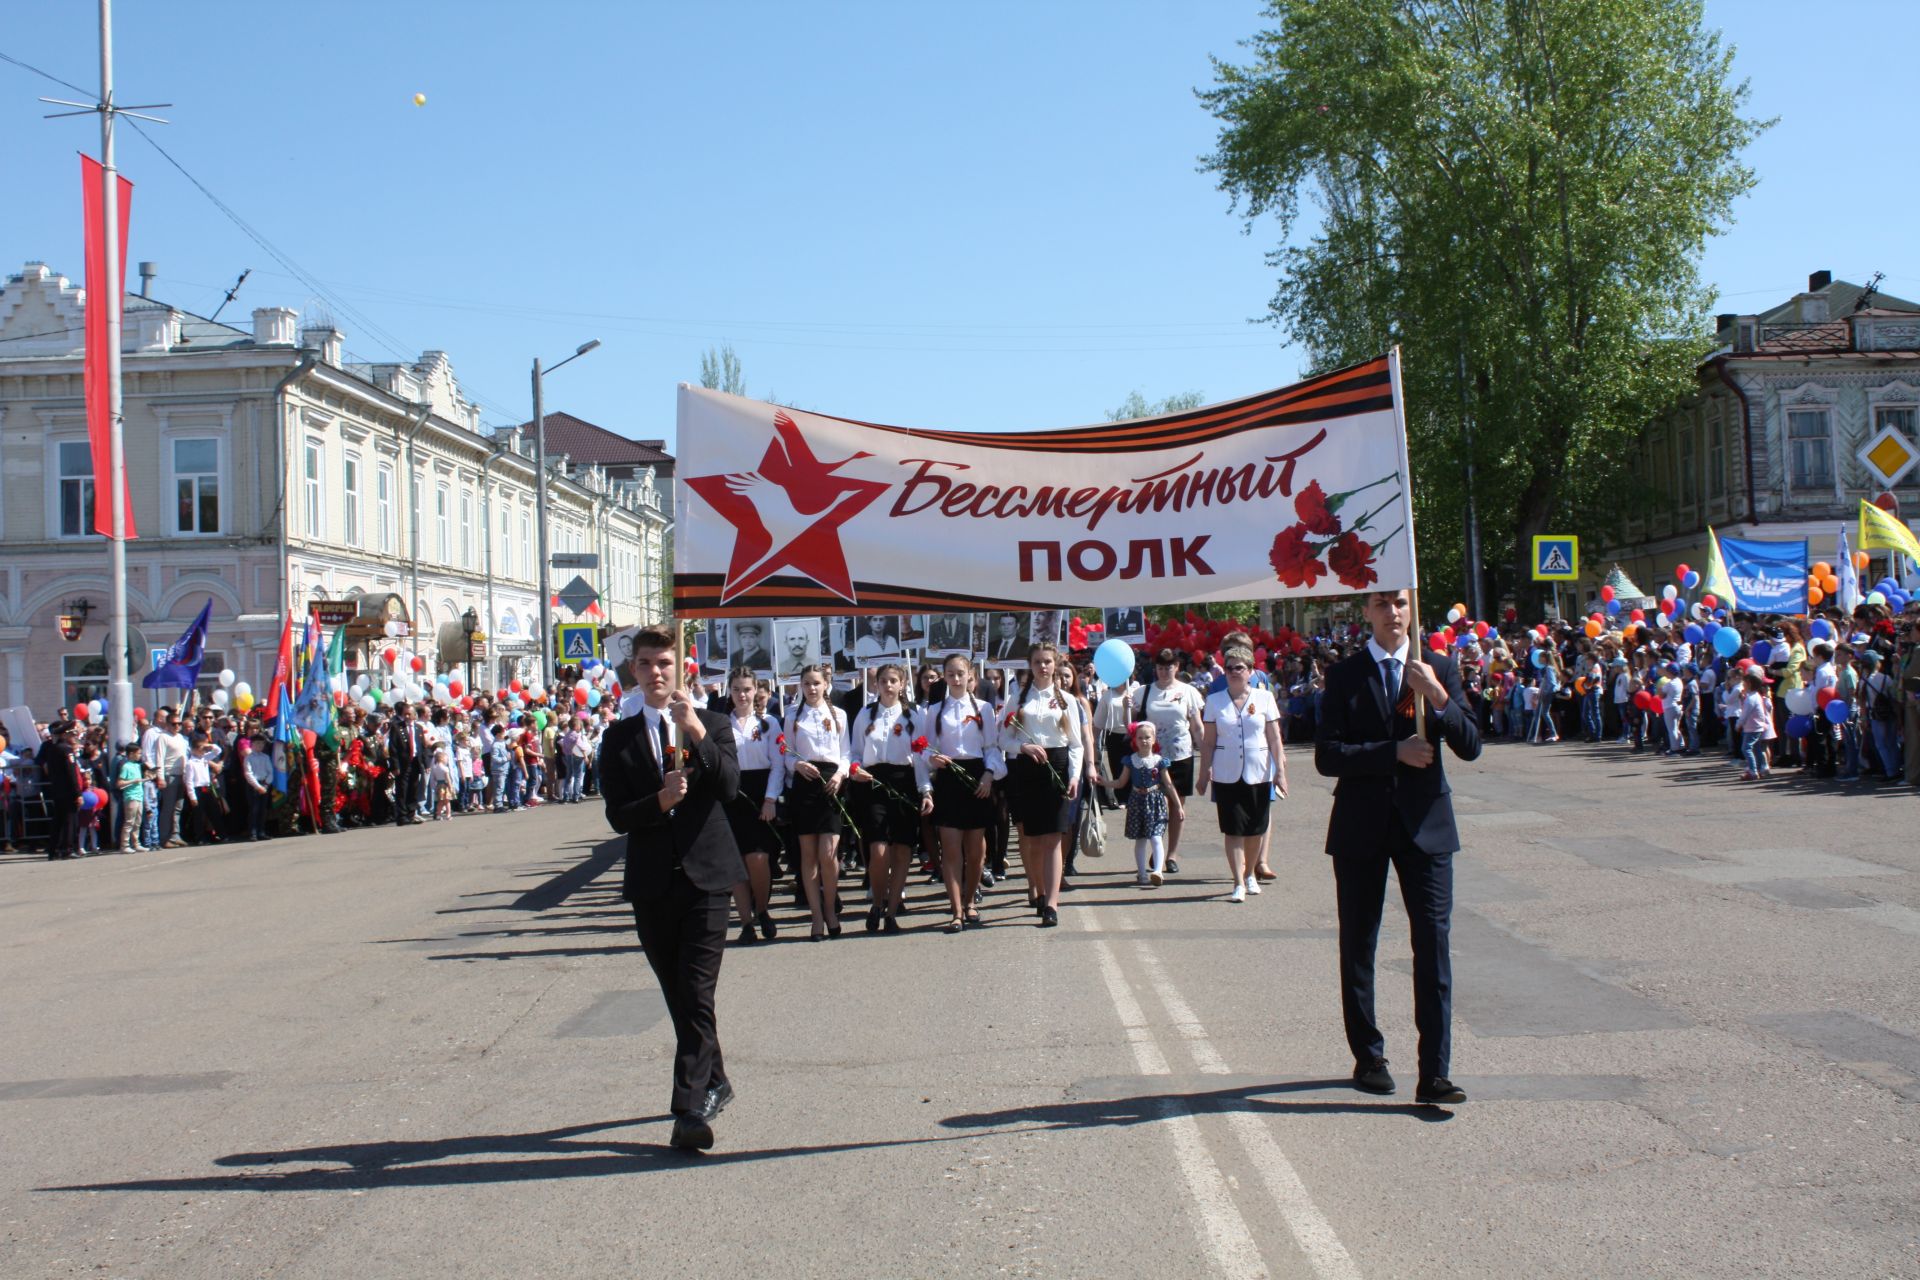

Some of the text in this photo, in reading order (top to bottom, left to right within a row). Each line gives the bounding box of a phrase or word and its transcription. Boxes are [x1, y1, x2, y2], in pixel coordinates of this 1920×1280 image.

[890, 428, 1327, 531] Бессмертный
[1019, 534, 1215, 582] ПОЛК
[1743, 576, 1780, 591] КАИ
